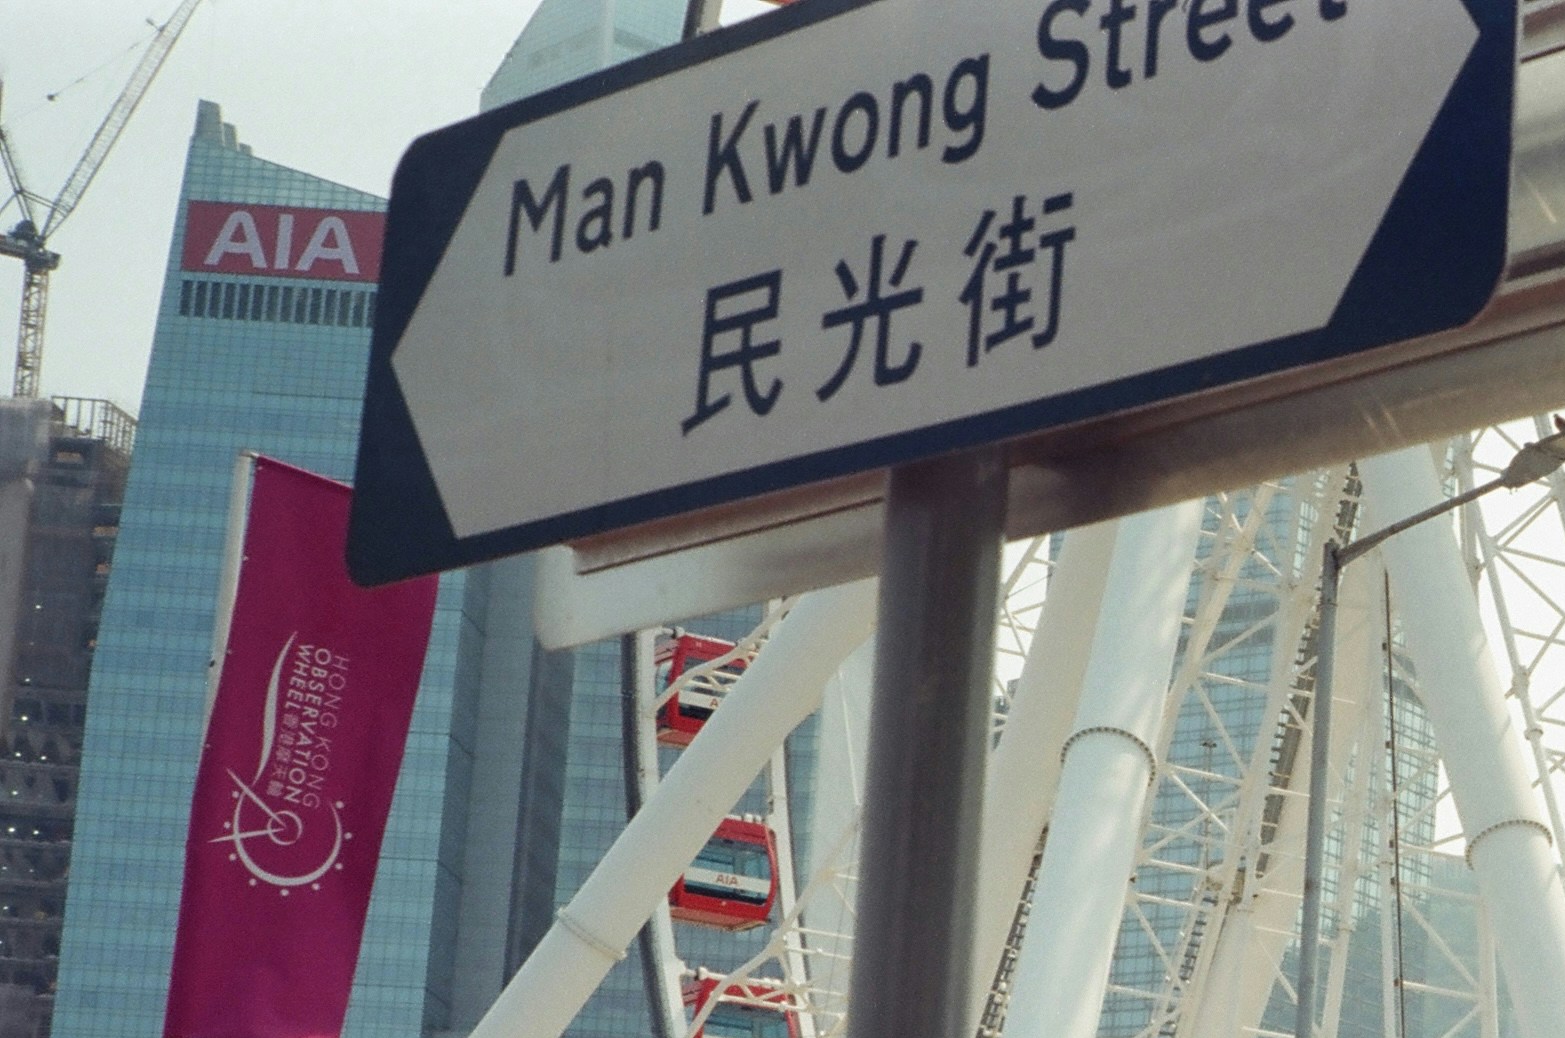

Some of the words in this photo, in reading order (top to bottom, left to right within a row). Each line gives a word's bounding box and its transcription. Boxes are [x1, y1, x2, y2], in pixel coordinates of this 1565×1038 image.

[502, 164, 665, 277] Man
[702, 52, 991, 215] Kwong
[1030, 0, 1348, 110] Stree
[204, 211, 360, 274] AIA
[680, 192, 1076, 438] 民光街
[284, 644, 315, 709] WHEEL
[319, 655, 350, 728] HONG
[284, 648, 331, 804] OBSERVATION
[302, 736, 332, 809] KONG
[715, 874, 740, 886] AIA
